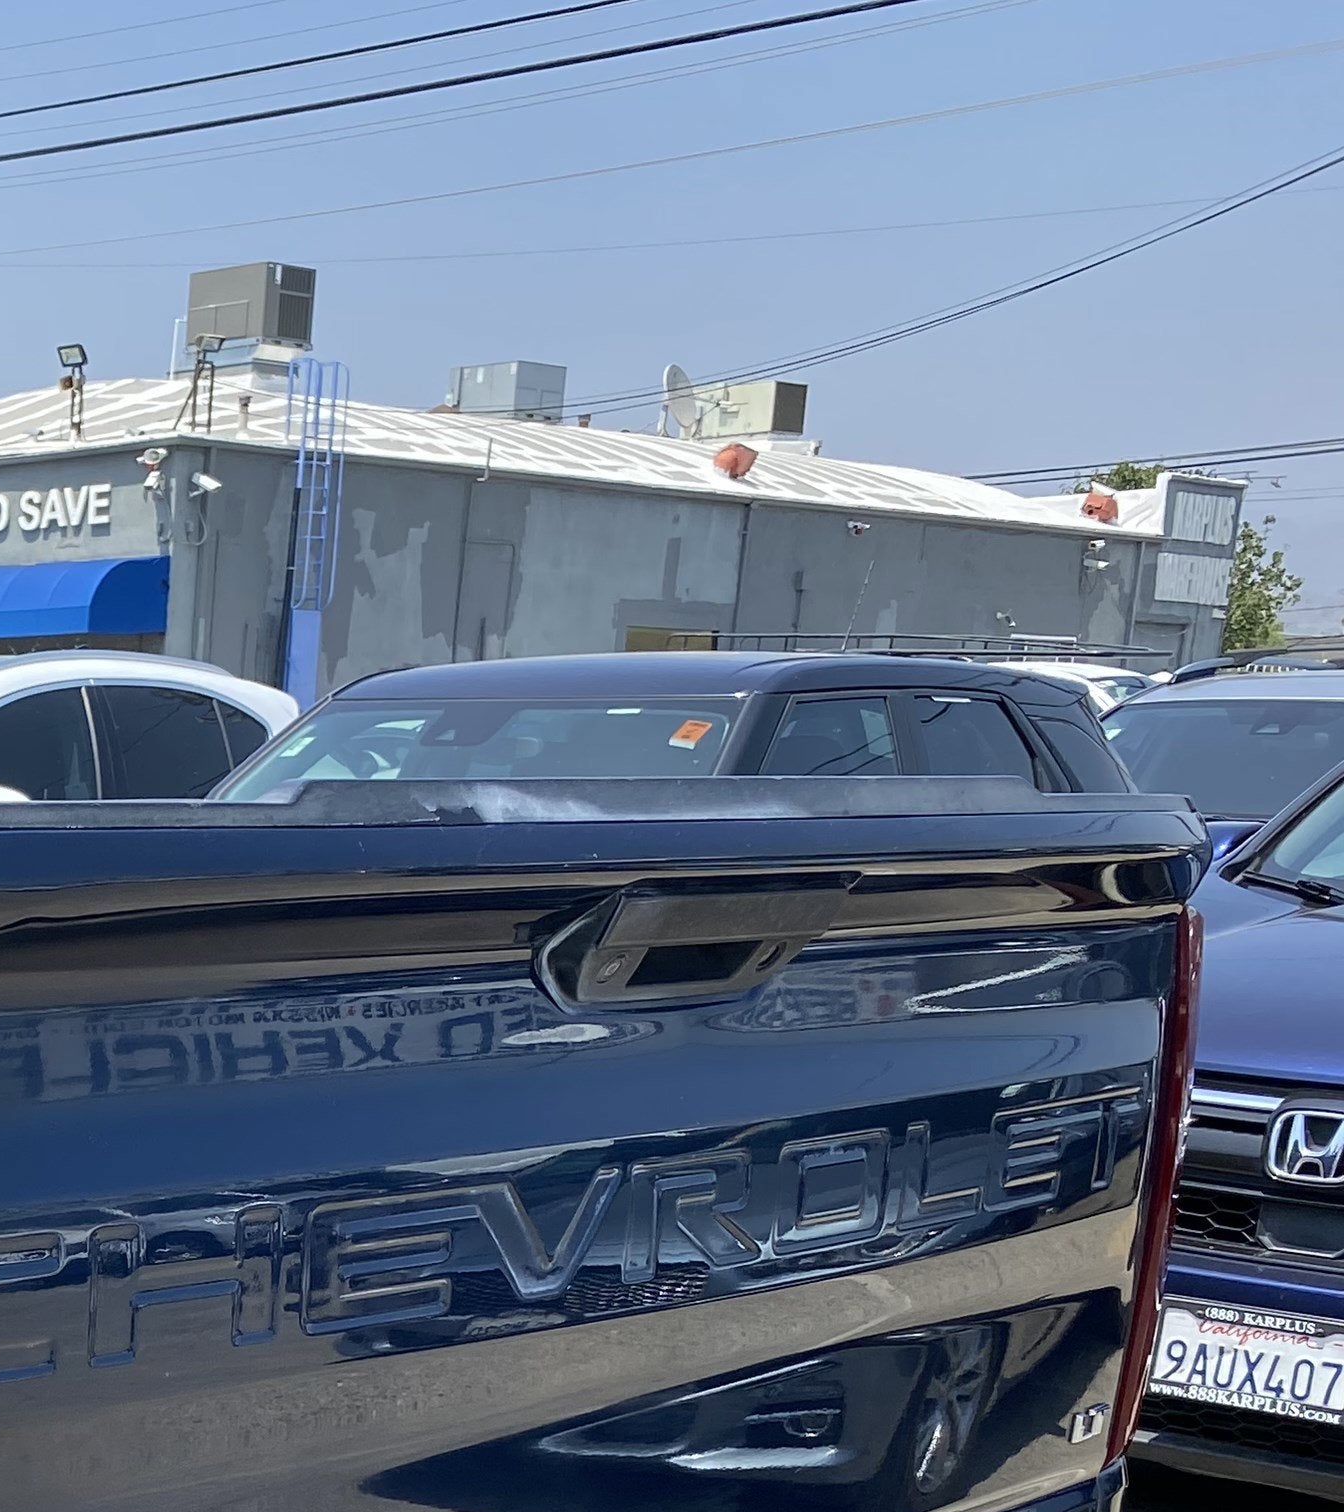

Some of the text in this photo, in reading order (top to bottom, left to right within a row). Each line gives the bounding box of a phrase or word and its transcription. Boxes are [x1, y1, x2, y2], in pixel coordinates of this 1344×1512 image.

[17, 483, 112, 532] SAVE
[1198, 1318, 1323, 1349] California
[1204, 1307, 1316, 1335] (888) KARPLUS
[1162, 1339, 1343, 1406] 9AUX407
